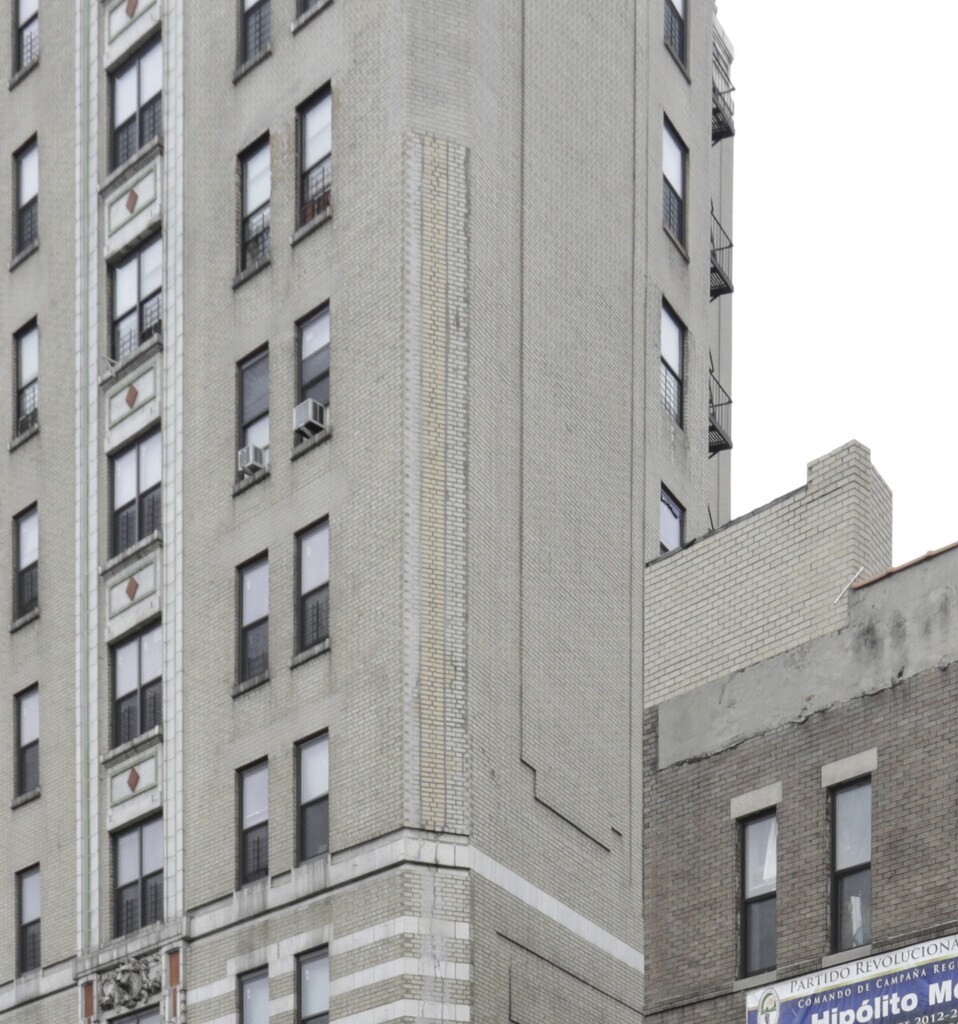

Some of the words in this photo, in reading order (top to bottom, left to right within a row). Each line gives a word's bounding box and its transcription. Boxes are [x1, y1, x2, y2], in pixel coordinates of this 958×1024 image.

[789, 966, 851, 993] PARTIDO
[798, 988, 852, 1009] COMANDO
[857, 983, 870, 993] DE
[876, 968, 927, 989] CAMPAÑA
